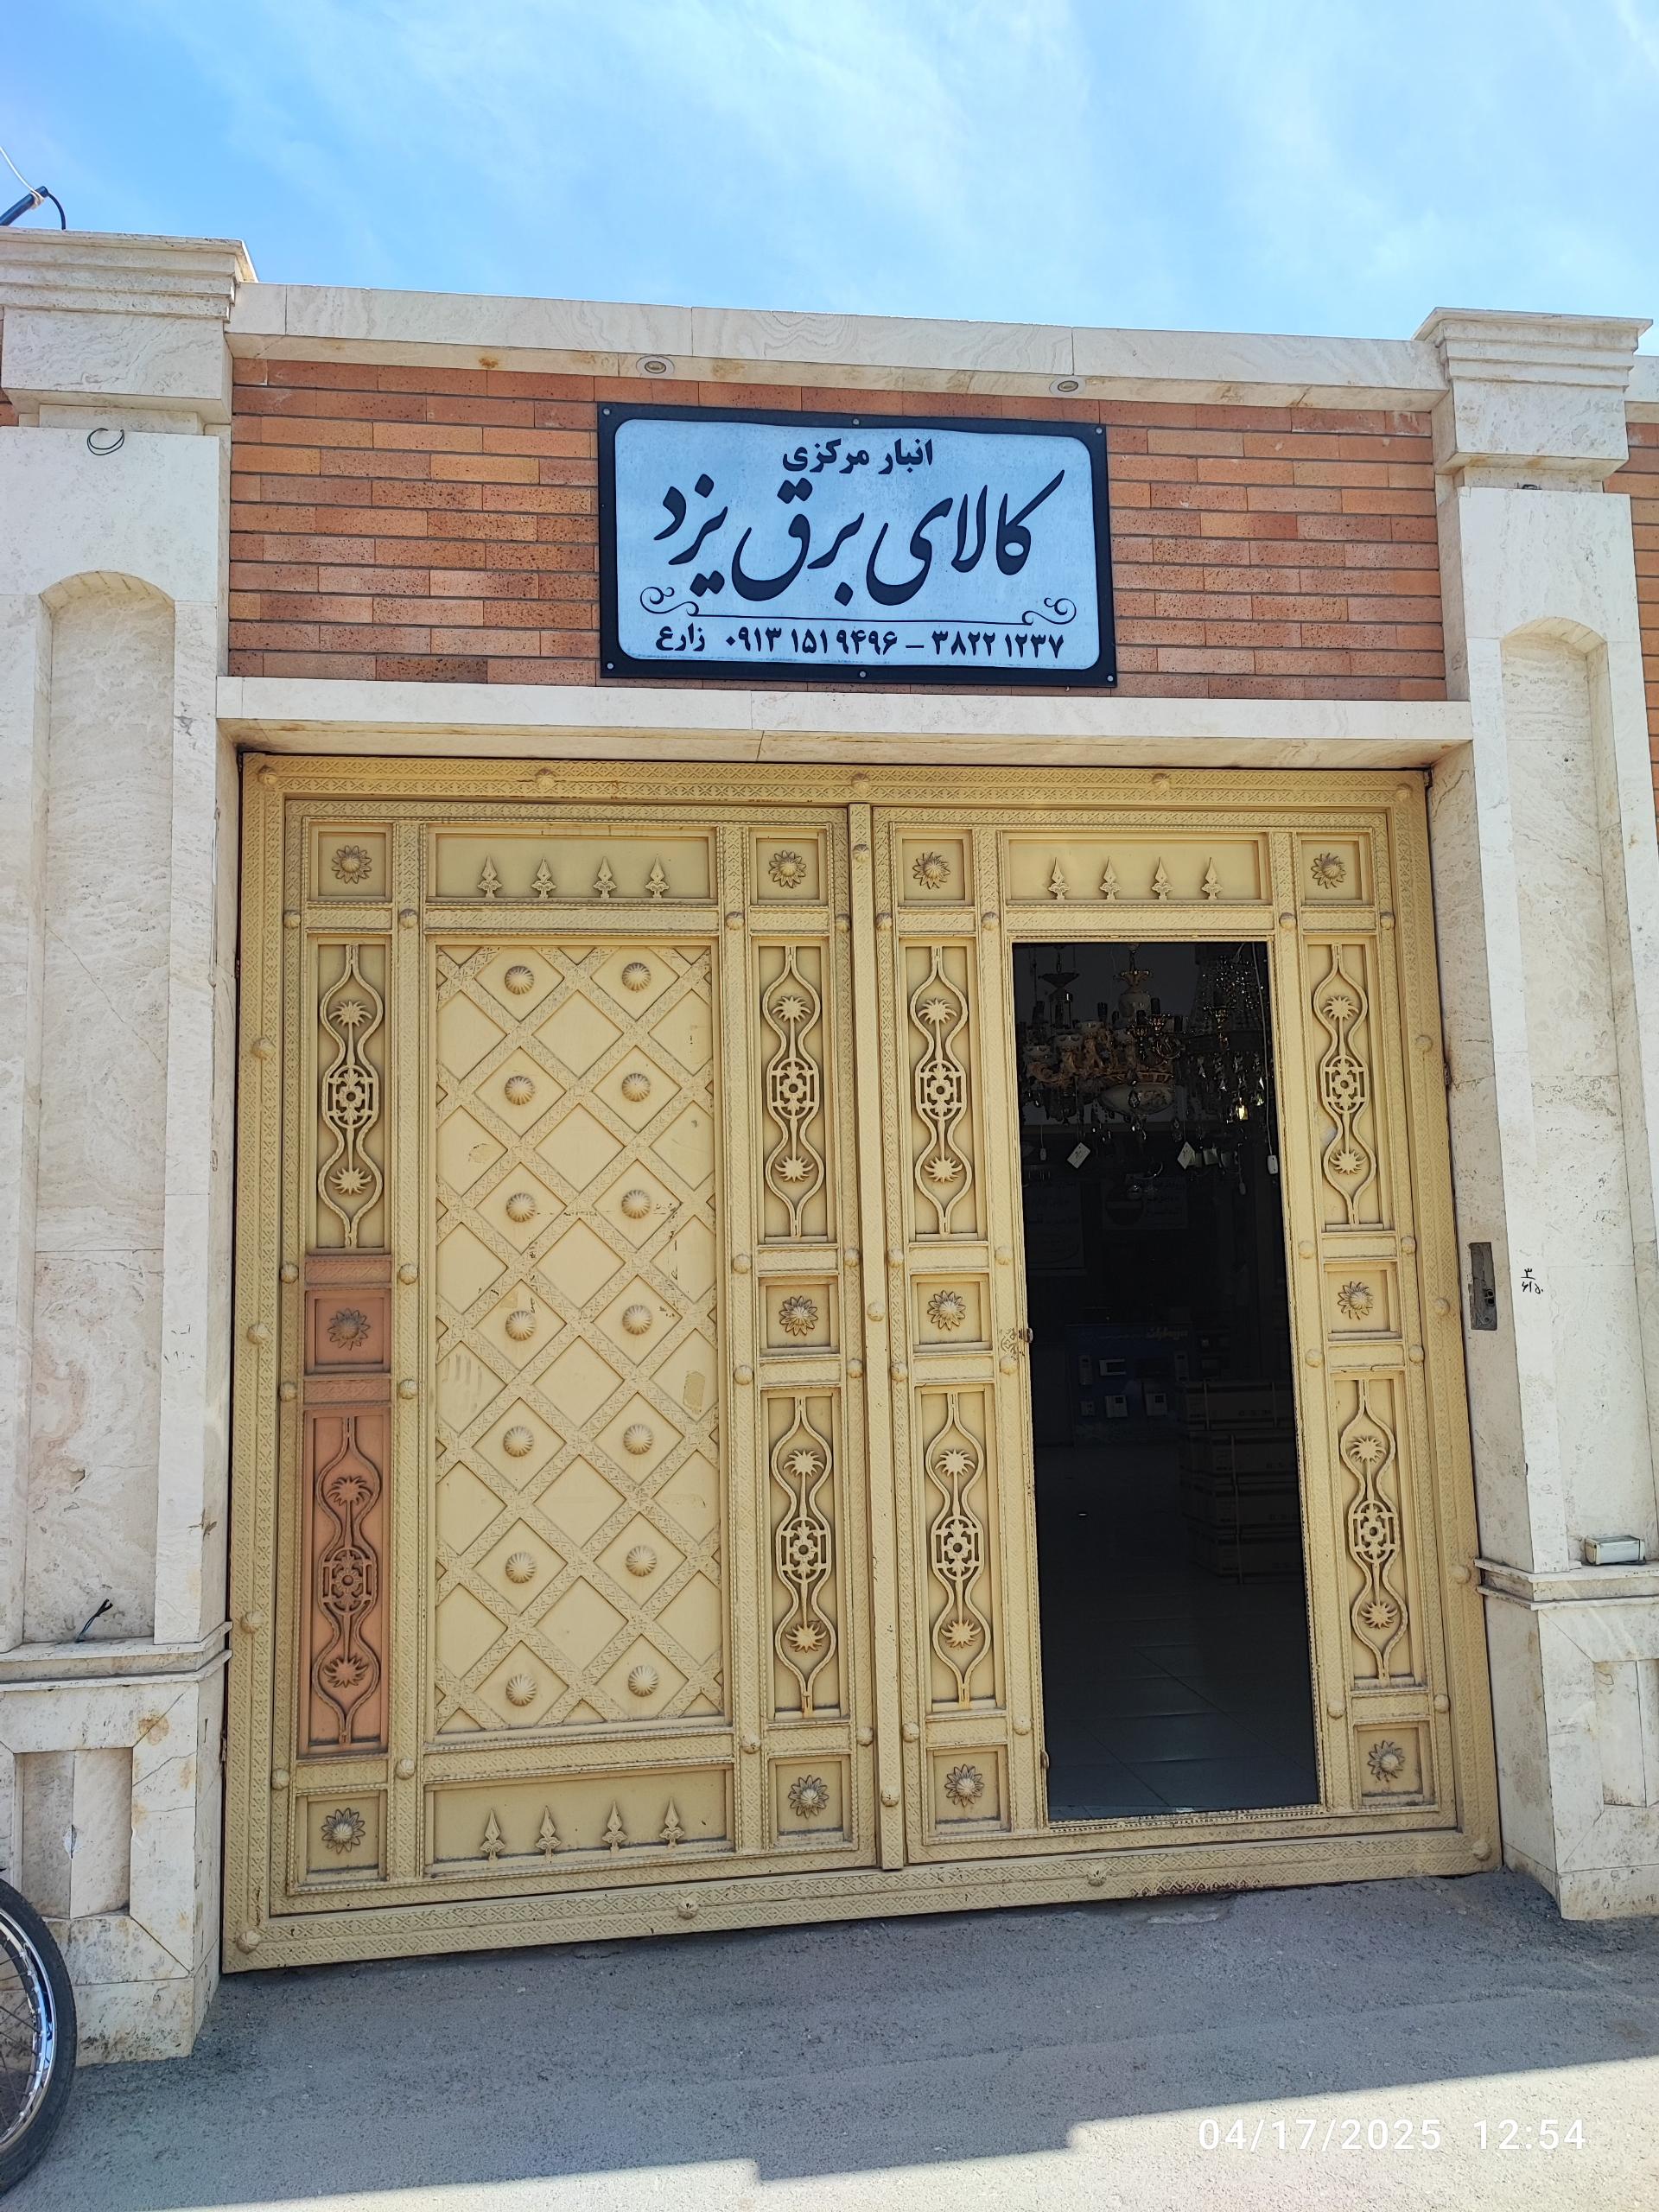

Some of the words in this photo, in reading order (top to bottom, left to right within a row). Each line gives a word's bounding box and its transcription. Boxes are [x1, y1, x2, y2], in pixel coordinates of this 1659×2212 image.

[782, 437, 870, 474] مرکزی
[877, 437, 933, 475] انبار
[653, 473, 728, 598] یزد
[731, 477, 865, 607] برق
[865, 469, 1065, 607] کالای
[655, 622, 706, 652] زارع
